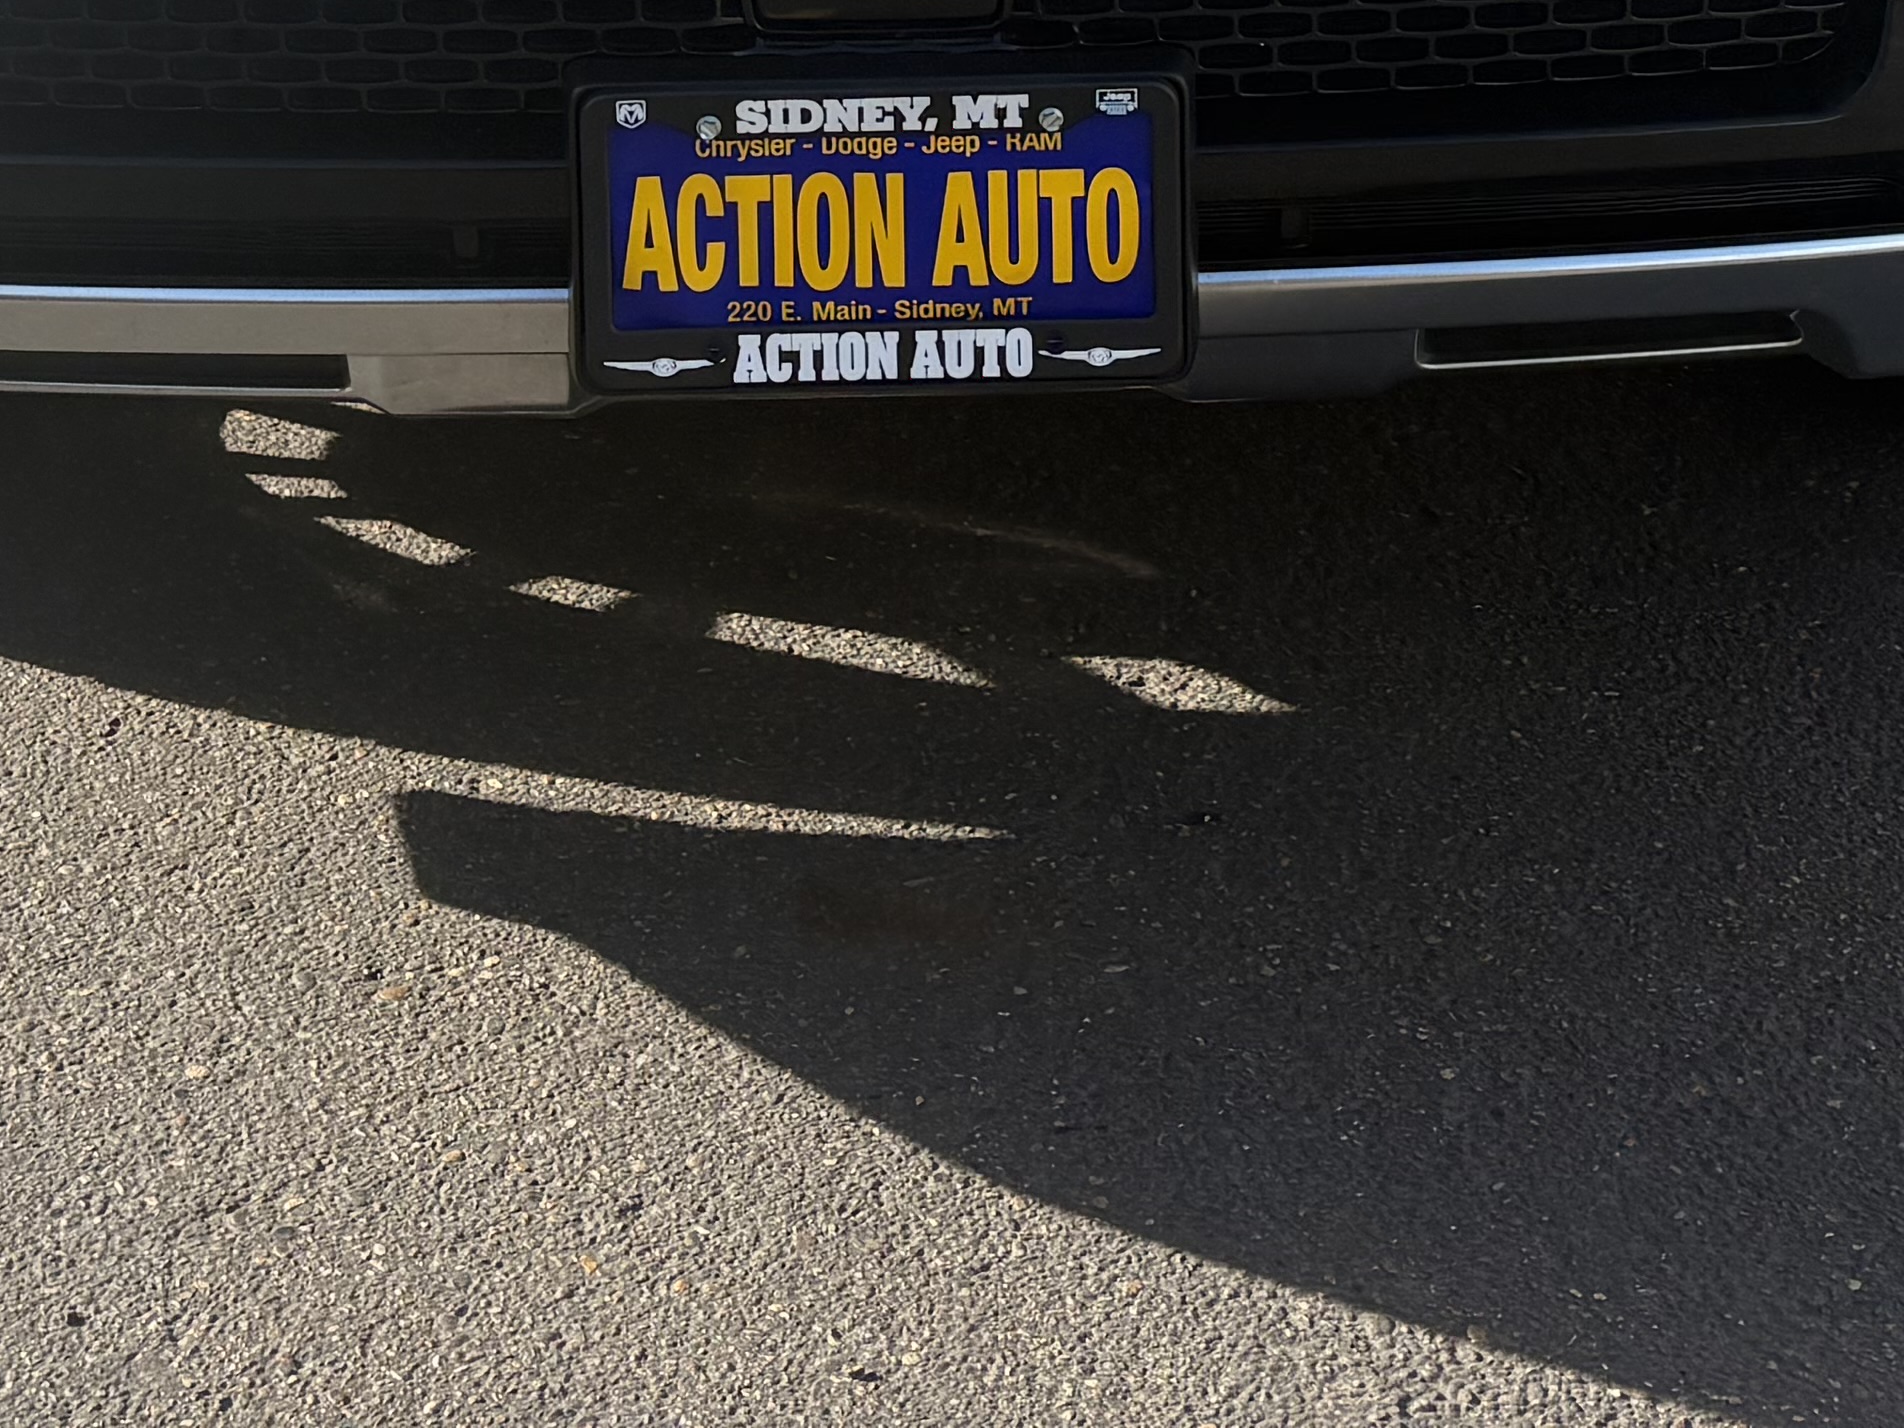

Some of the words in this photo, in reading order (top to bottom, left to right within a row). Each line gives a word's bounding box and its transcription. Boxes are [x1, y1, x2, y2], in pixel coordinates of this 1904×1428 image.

[735, 97, 939, 134] SIDNEY,
[952, 94, 1029, 130] MT
[696, 137, 795, 162] Chrysler
[822, 135, 897, 159] Dodge
[922, 133, 980, 157] Jeep
[1006, 132, 1062, 152] RAM
[622, 171, 905, 292] ACTION
[931, 167, 1140, 287] AUTO
[727, 300, 772, 323] 220
[781, 301, 802, 321] E.
[812, 300, 872, 321] Main
[894, 299, 984, 321] Sidney,
[992, 297, 1033, 316] MT
[733, 330, 899, 383] ACTION
[910, 327, 1034, 379] AUTO
